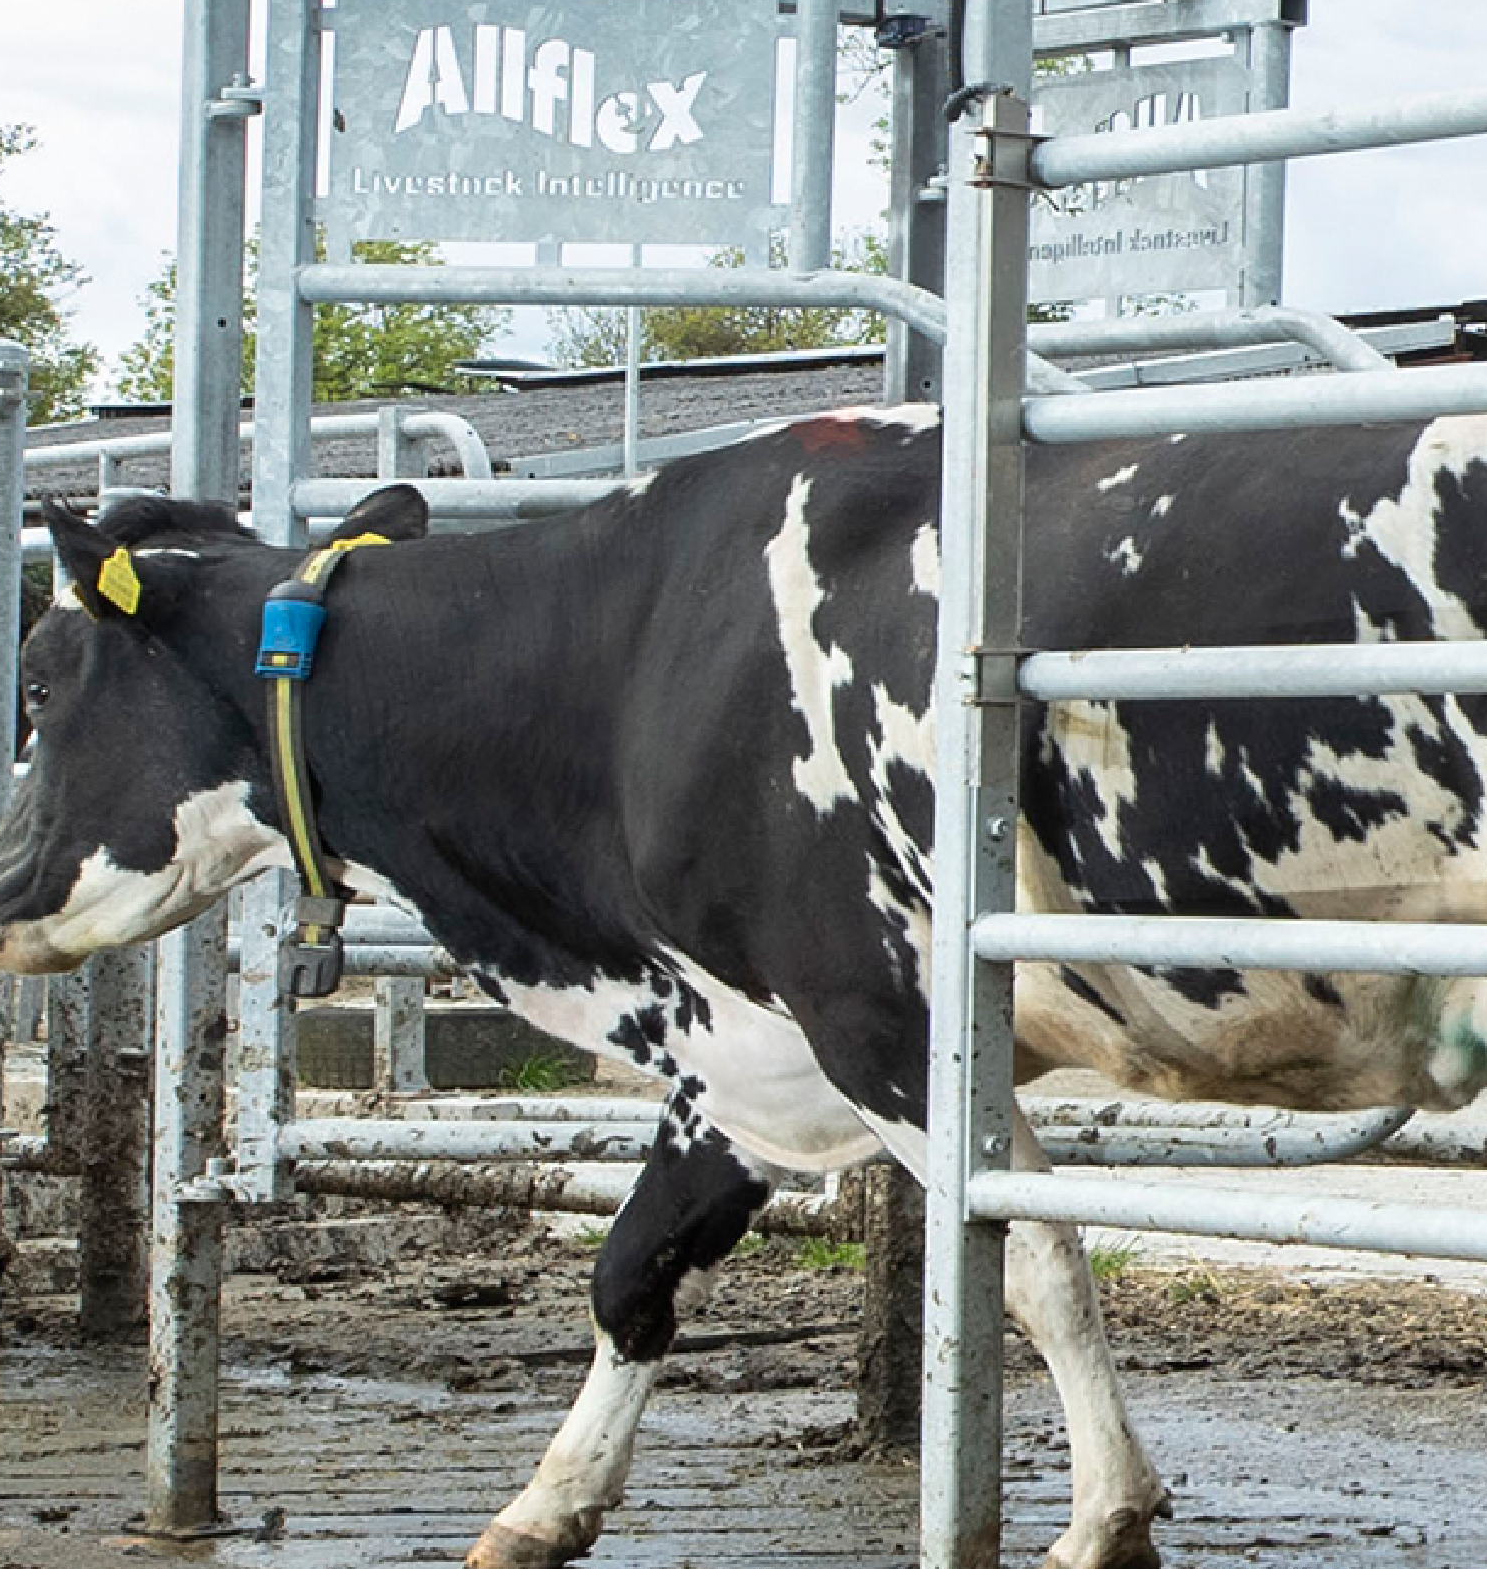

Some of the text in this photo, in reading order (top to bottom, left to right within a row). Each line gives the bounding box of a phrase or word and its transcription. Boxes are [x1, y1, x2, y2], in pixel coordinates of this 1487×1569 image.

[394, 24, 708, 154] Allflex
[353, 167, 745, 204] Livestock Intelligence
